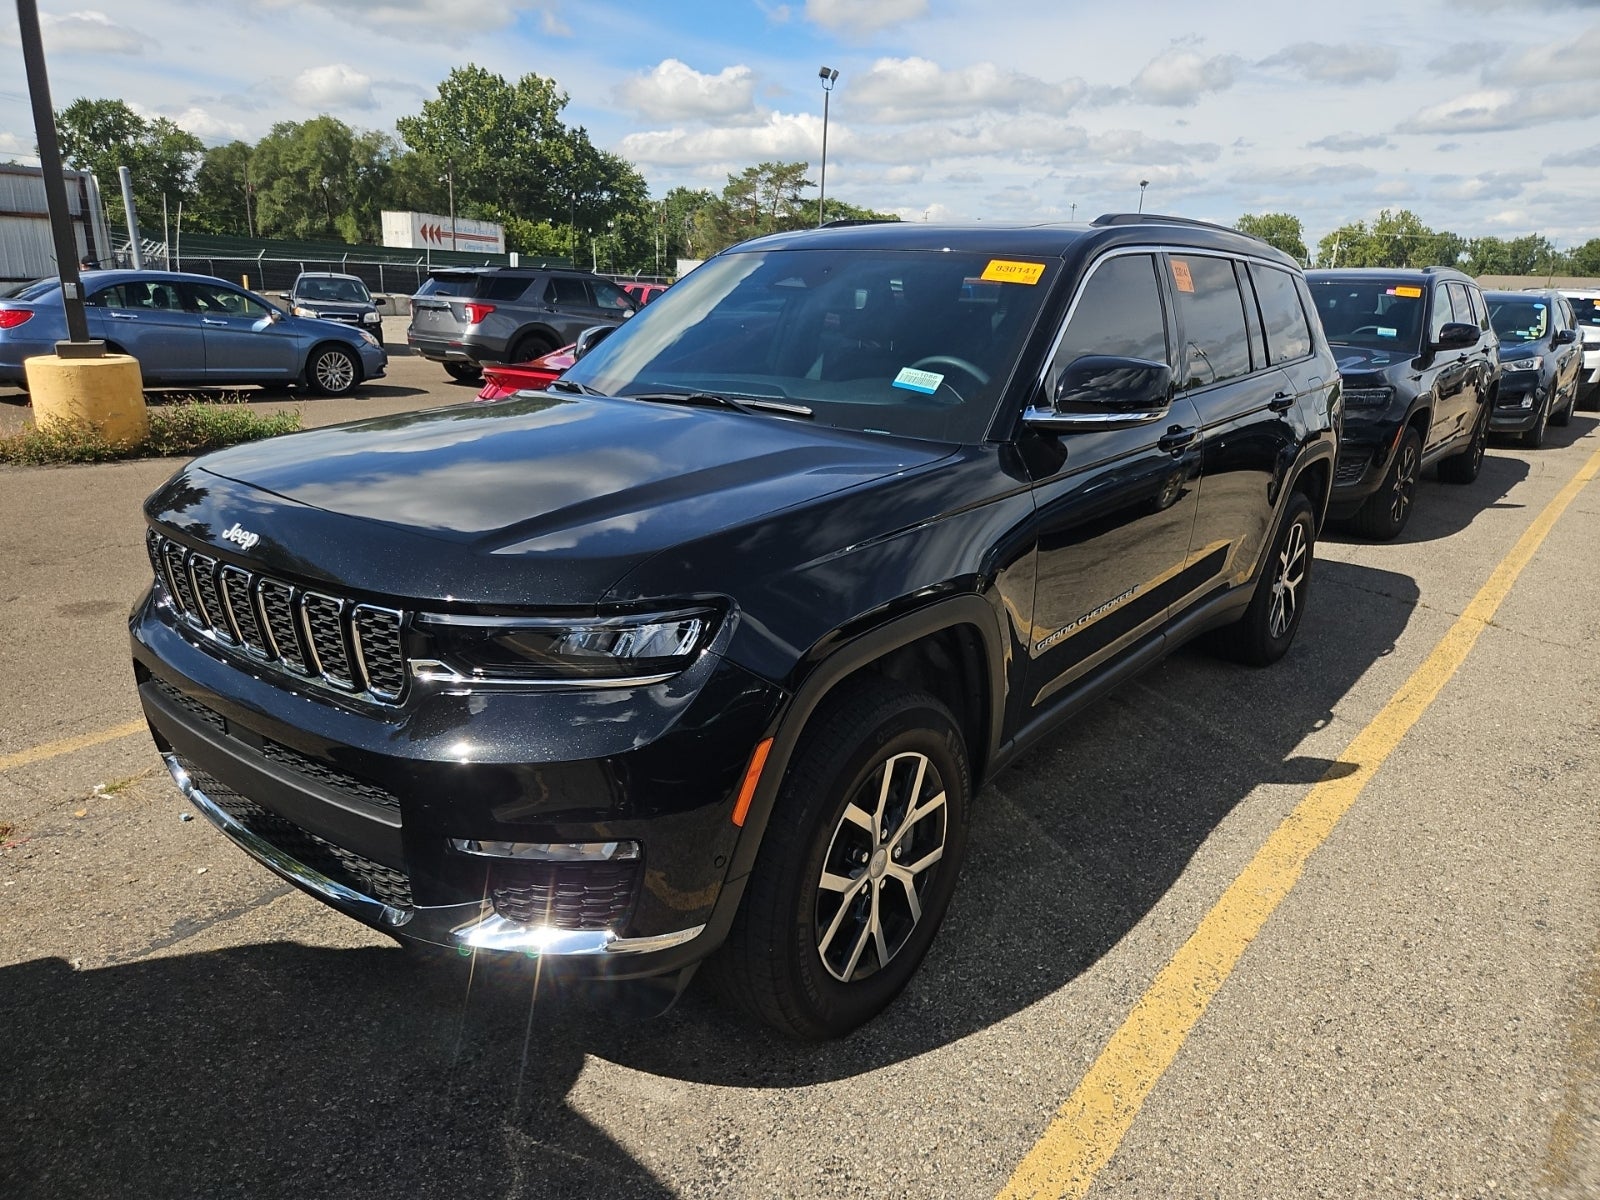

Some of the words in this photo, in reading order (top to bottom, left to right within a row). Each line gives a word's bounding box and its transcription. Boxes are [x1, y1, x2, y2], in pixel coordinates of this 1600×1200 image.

[222, 522, 260, 551] Jeep
[1036, 621, 1076, 651] GRAND
[1076, 589, 1133, 626] CHEROKEE
